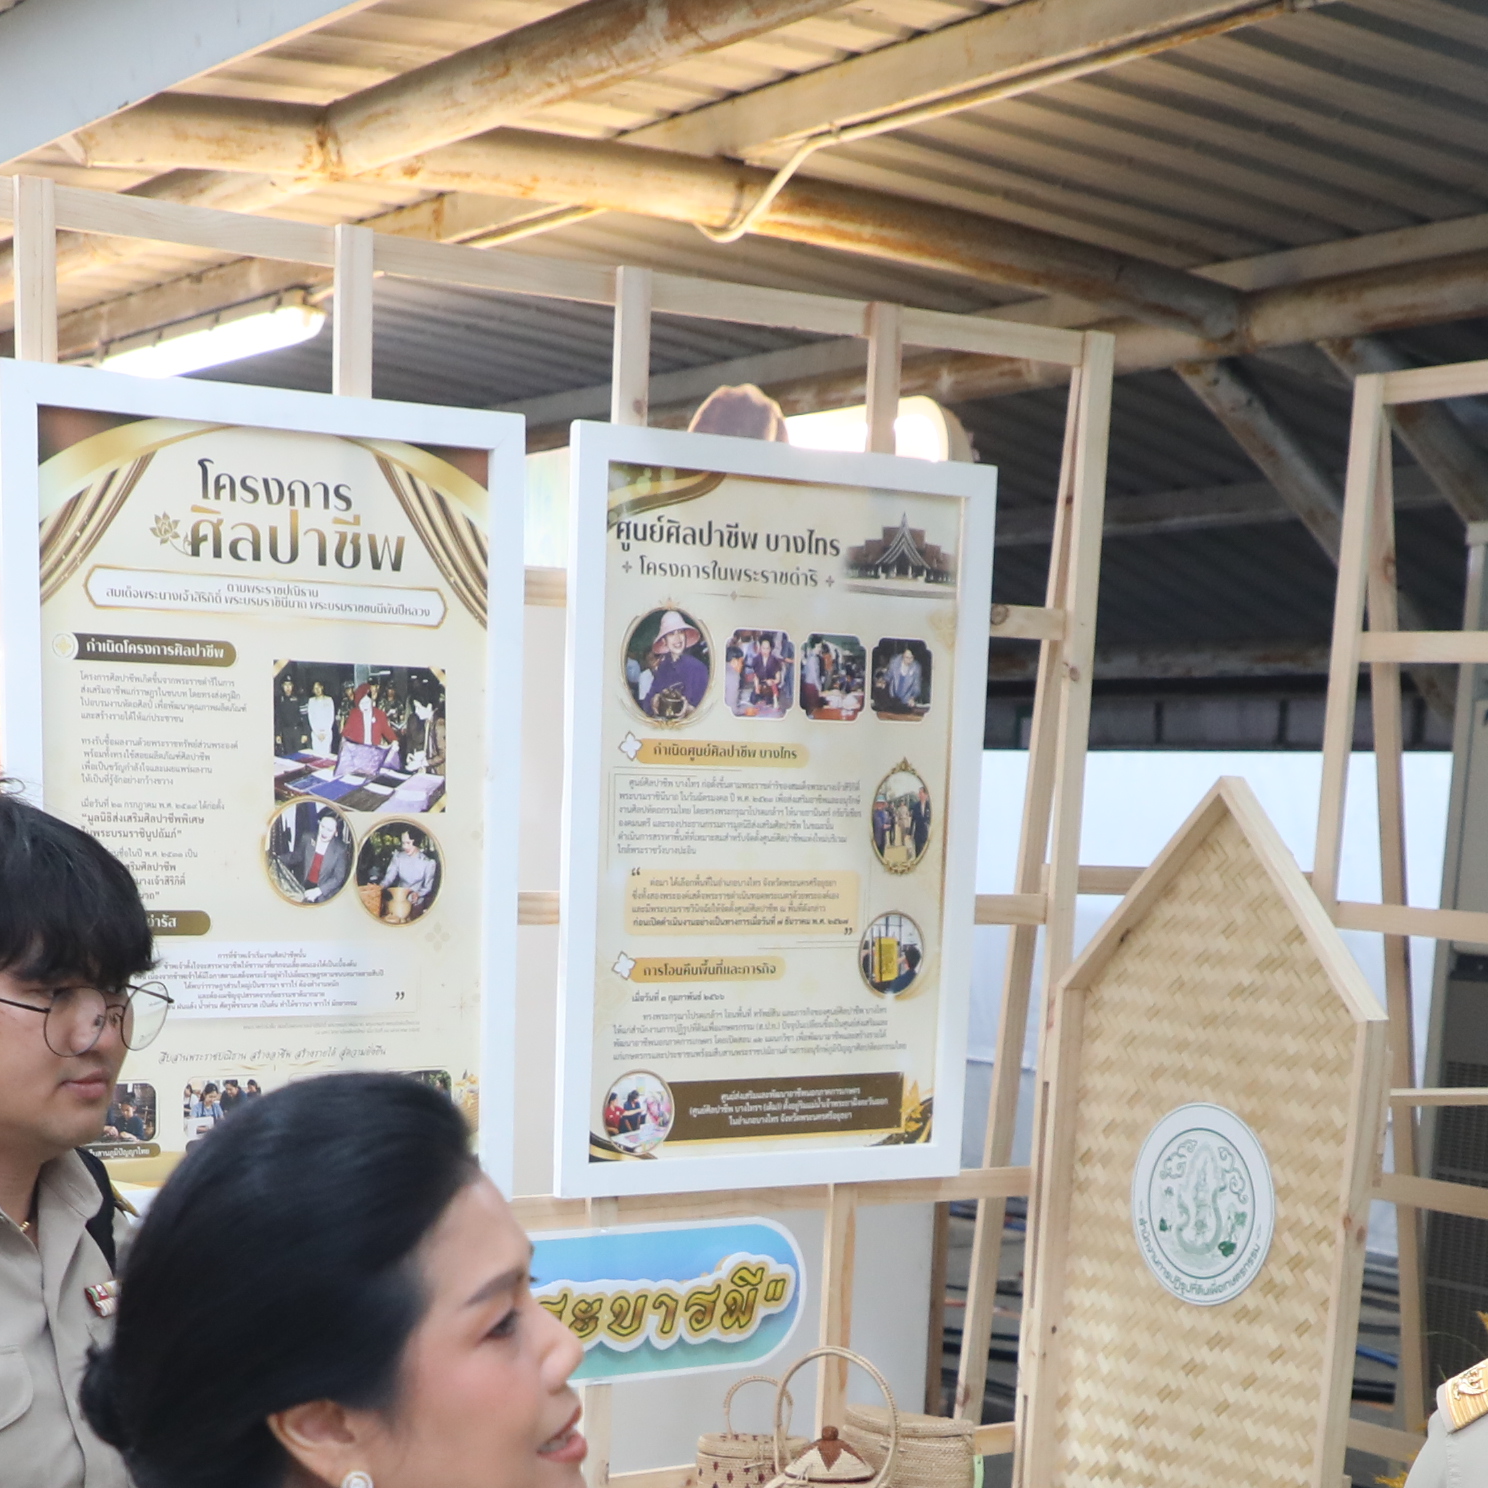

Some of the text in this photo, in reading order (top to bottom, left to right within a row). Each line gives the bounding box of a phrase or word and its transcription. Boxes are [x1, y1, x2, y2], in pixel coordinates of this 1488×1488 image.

[198, 458, 353, 512] โครงการ
[190, 504, 406, 572] ศิลปาชีพ
[616, 514, 841, 557] ศูนย์ศิลปาชีพ บางไทร
[639, 555, 818, 587] โครงการในพระราชดำริ
[105, 587, 222, 605] สมเด็จพระนางเจ้าสิริกิติ์
[226, 583, 319, 598] ตามพระราชปณิธาน
[86, 636, 225, 660] กำเนิดโครงการศิลปาชีพ
[653, 743, 798, 762] กำเนิดศูนย์ศิลปาชีพ บางไทร
[643, 959, 776, 976] การโอนคืนพื้นที่และภารกิจ
